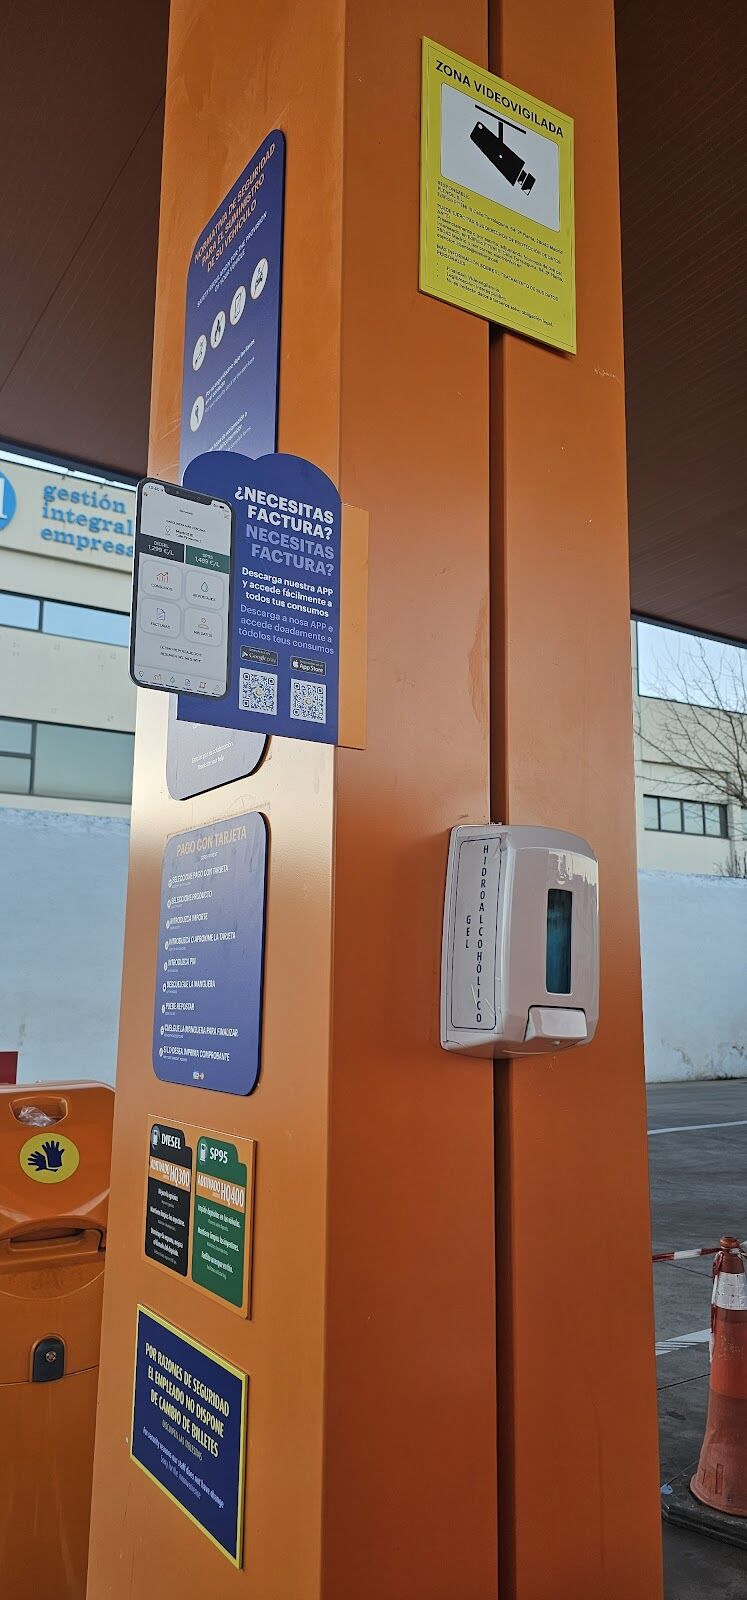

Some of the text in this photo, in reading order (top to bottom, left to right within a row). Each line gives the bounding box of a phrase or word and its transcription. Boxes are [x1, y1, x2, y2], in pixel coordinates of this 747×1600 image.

[436, 59, 563, 137] ZONA VIDEOVIGILADA
[195, 142, 274, 263] NORMATIVA DE SEGURIDAD
[201, 171, 264, 267] PARA EL SUMINISTRO
[207, 196, 257, 272] DE SU VEHÍCULO
[43, 485, 127, 514] gestión
[234, 486, 334, 524] ¿NECESITAS
[42, 502, 134, 536] integral
[247, 504, 333, 540] FACTURA?
[154, 540, 169, 549] DIESEL
[246, 523, 335, 560] NECESITAS
[251, 543, 335, 576] FACTURA?
[241, 566, 333, 596] Descarga nuestra APP
[242, 580, 247, 588] y
[249, 582, 281, 595] accede
[282, 587, 326, 606] fácilmente
[240, 604, 280, 621] Descarga
[282, 614, 287, 622] a
[289, 617, 309, 627] nosa
[310, 620, 327, 630] APP
[246, 591, 329, 618] todos tus consumos
[238, 627, 334, 655] tódolos teus consumos
[240, 617, 272, 630] accede
[274, 622, 326, 641] doadamente
[248, 652, 267, 662] Google
[299, 662, 310, 671] App
[310, 664, 324, 673] Store
[176, 840, 195, 857] PAGO
[197, 835, 213, 851] CON
[215, 825, 247, 847] TARJETA
[476, 844, 489, 1023] HIDROALCOHÓLICO
[165, 1002, 194, 1011] PUEDE REPOSTAR
[161, 1133, 182, 1150] DIESEL
[209, 1146, 228, 1164] SP95
[169, 1167, 190, 1188] HQ300
[220, 1181, 245, 1208] HQ400
[145, 1343, 230, 1418] POR RAZONES DE SEGURIDAD
[148, 1365, 224, 1437] EL EMPLEADO NO DISPONE
[150, 1389, 218, 1458] DE CAMBIO DE BILLETES
